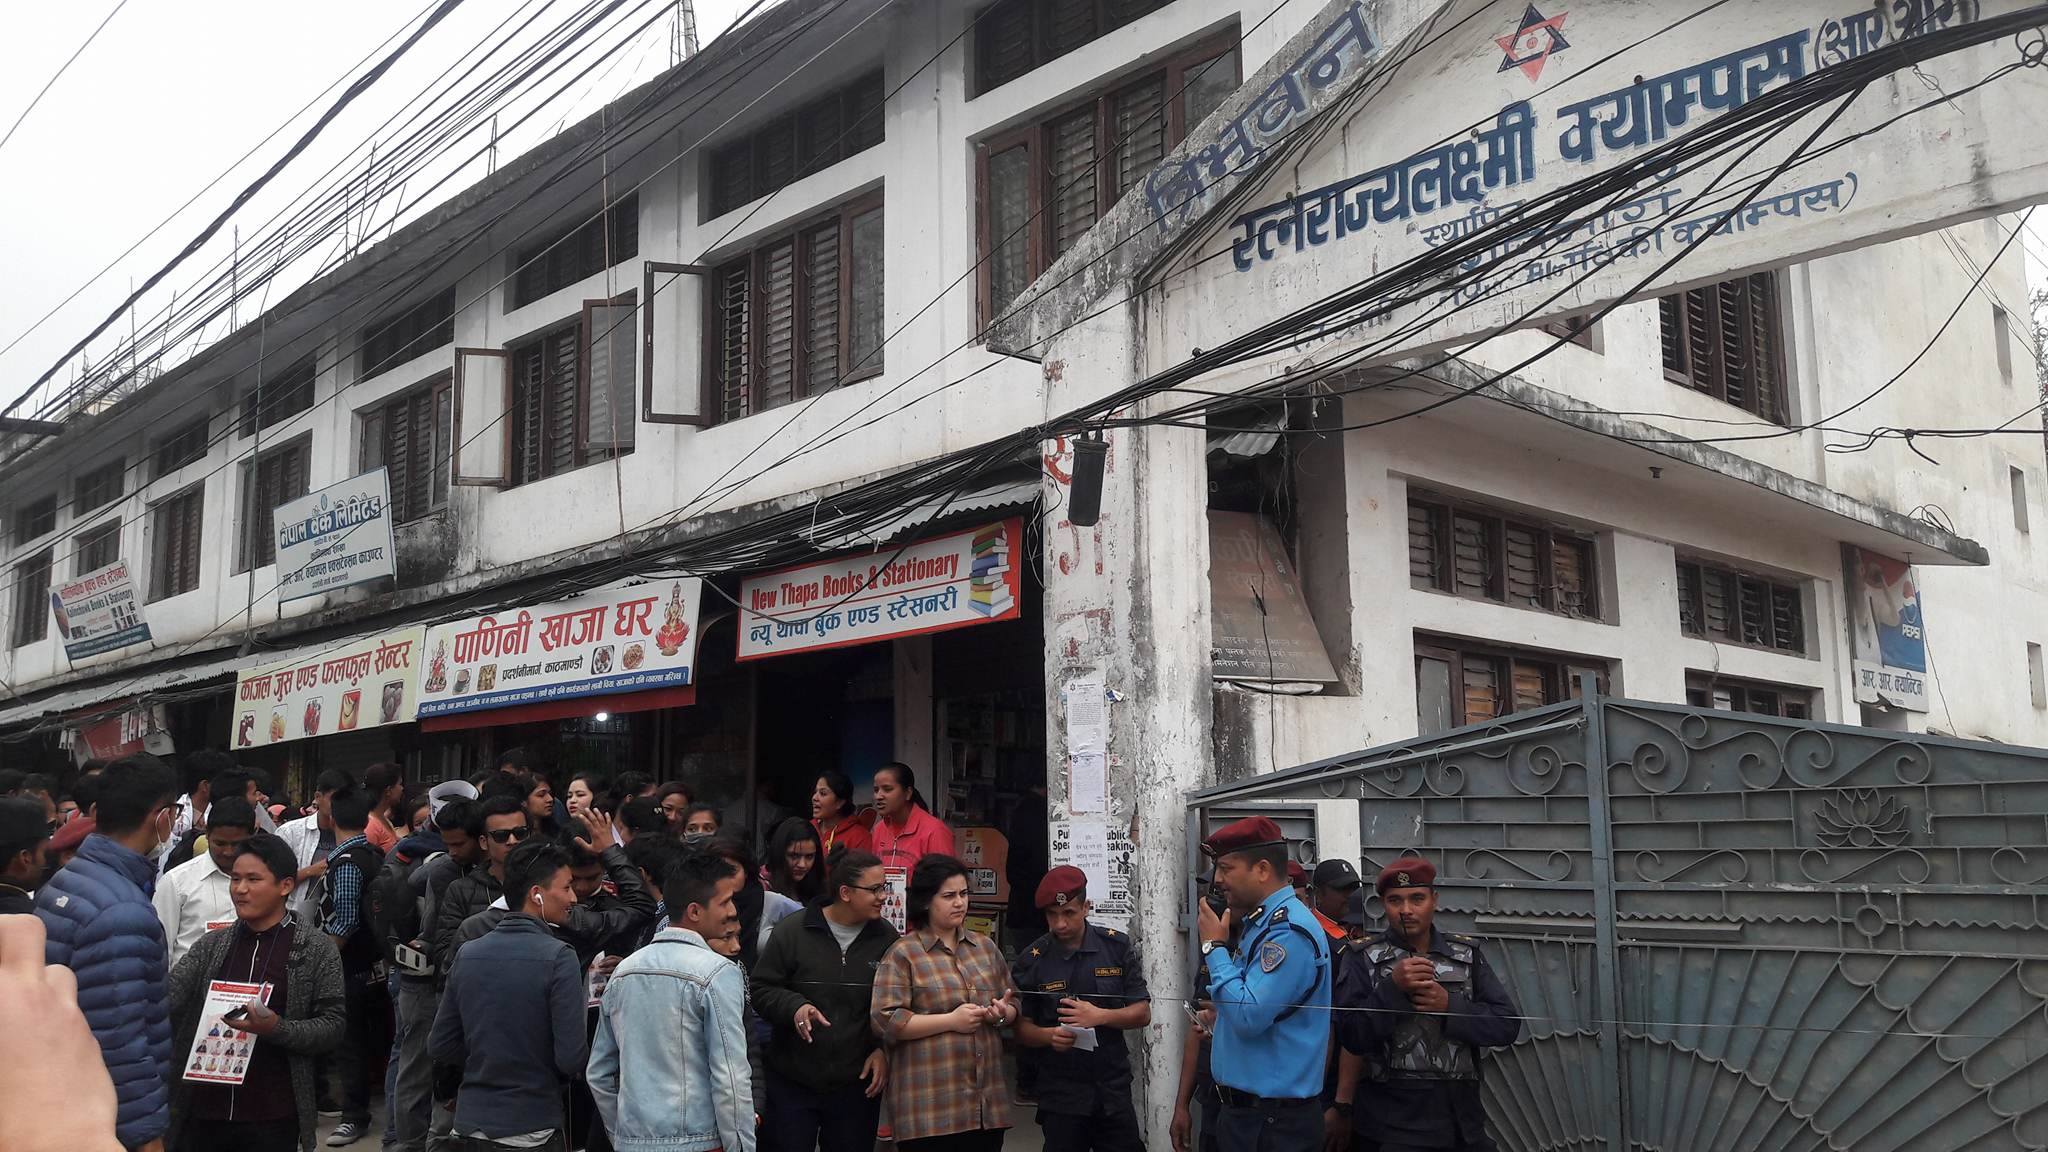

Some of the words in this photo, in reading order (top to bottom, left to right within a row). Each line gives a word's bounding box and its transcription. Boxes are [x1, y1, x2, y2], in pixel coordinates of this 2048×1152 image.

[1230, 100, 1537, 272] रत्नराज्यलक्ष्मी
[1556, 28, 1811, 165] क्याम्पस
[280, 521, 307, 547] नेपाल
[752, 587, 778, 611] New
[781, 578, 819, 607] Thapa
[823, 571, 863, 599] Books
[868, 565, 880, 591] &
[882, 552, 960, 586] Stationary
[453, 609, 534, 664] पाणिनी
[539, 606, 608, 652] खाजा
[614, 596, 659, 638] घर
[750, 622, 772, 646] न्यू
[776, 616, 810, 640] थापा
[814, 612, 841, 637] बुक
[847, 604, 881, 627] एण्ड
[887, 585, 959, 621] स्टेसनरी
[1902, 624, 1921, 640] PEPSI
[241, 675, 272, 702] काजल
[274, 670, 294, 702] जुस
[296, 664, 320, 691] एण्ड
[322, 651, 372, 687] फलफुल
[374, 639, 413, 675] सेन्टर
[1107, 829, 1126, 840] ublic
